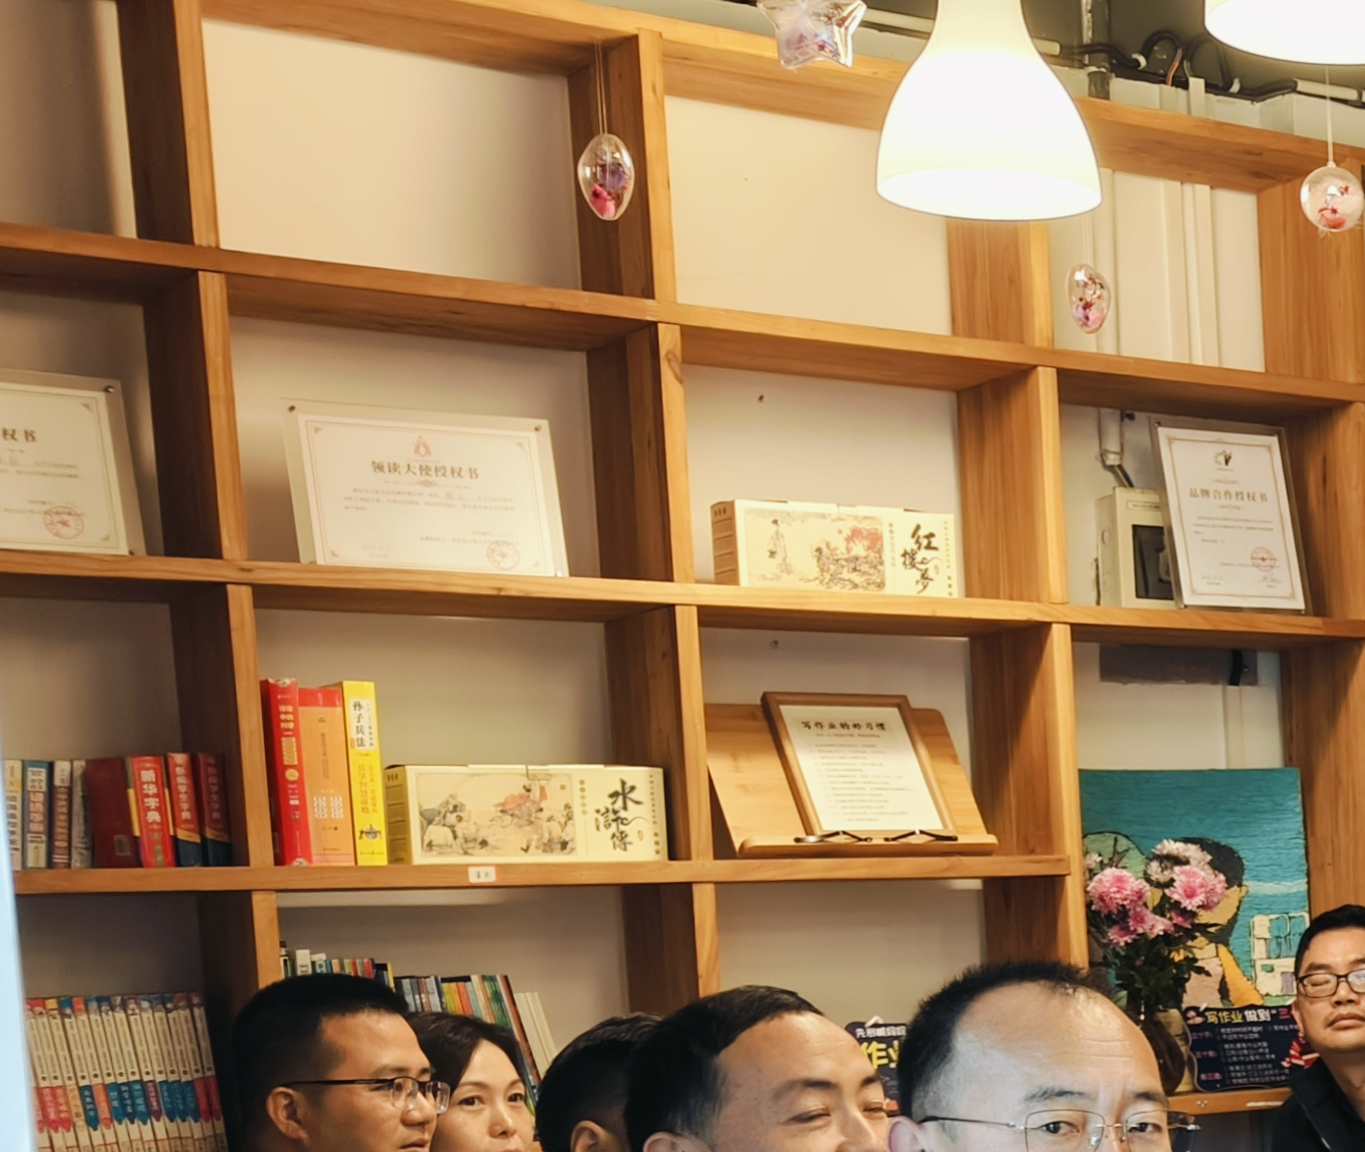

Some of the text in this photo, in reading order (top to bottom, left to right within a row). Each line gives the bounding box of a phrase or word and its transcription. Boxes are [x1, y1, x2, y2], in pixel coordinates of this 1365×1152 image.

[371, 460, 480, 480] 领读大使授权书
[352, 701, 366, 748] 孙子兵法
[140, 769, 163, 823] 新华字典
